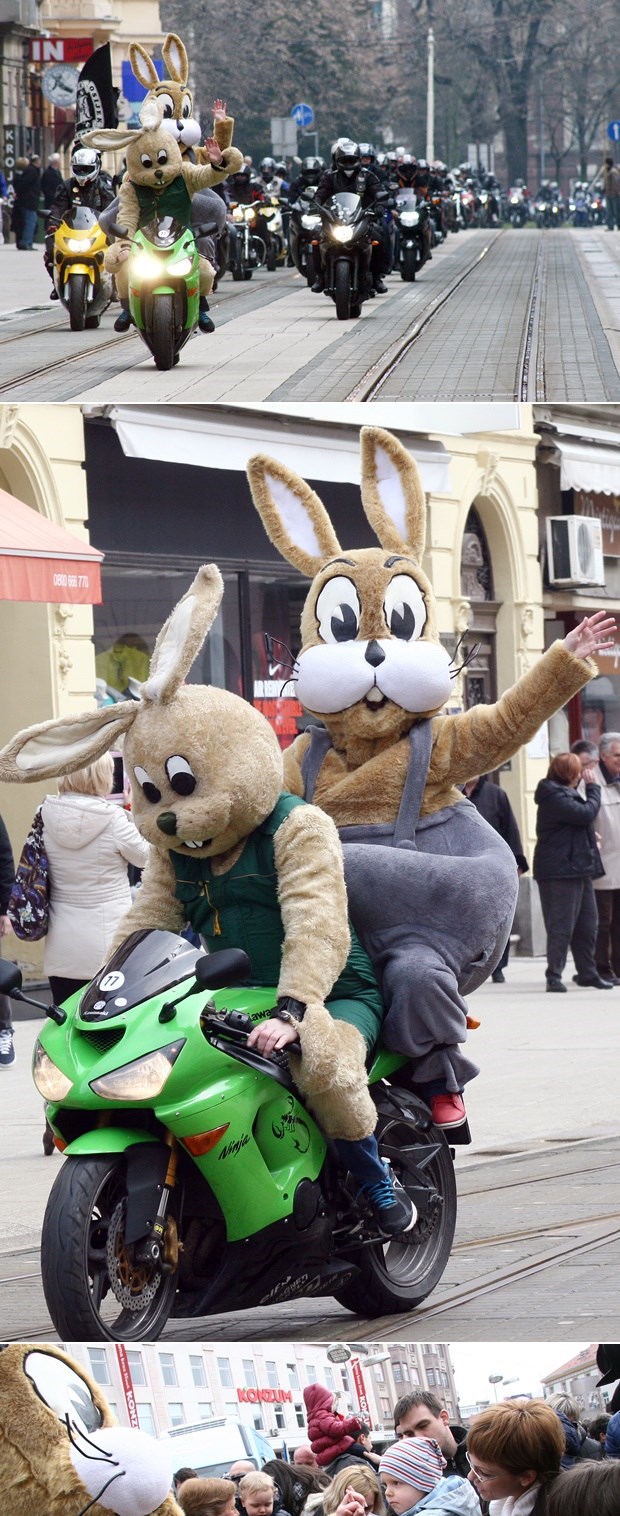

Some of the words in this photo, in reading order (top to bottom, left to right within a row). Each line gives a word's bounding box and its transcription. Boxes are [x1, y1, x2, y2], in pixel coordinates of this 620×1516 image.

[32, 41, 64, 61] IN
[89, 85, 103, 123] OSIJEK
[218, 1133, 251, 1160] Ninja
[237, 1388, 293, 1403] KONZUM
[126, 1390, 139, 1429] KONZ
